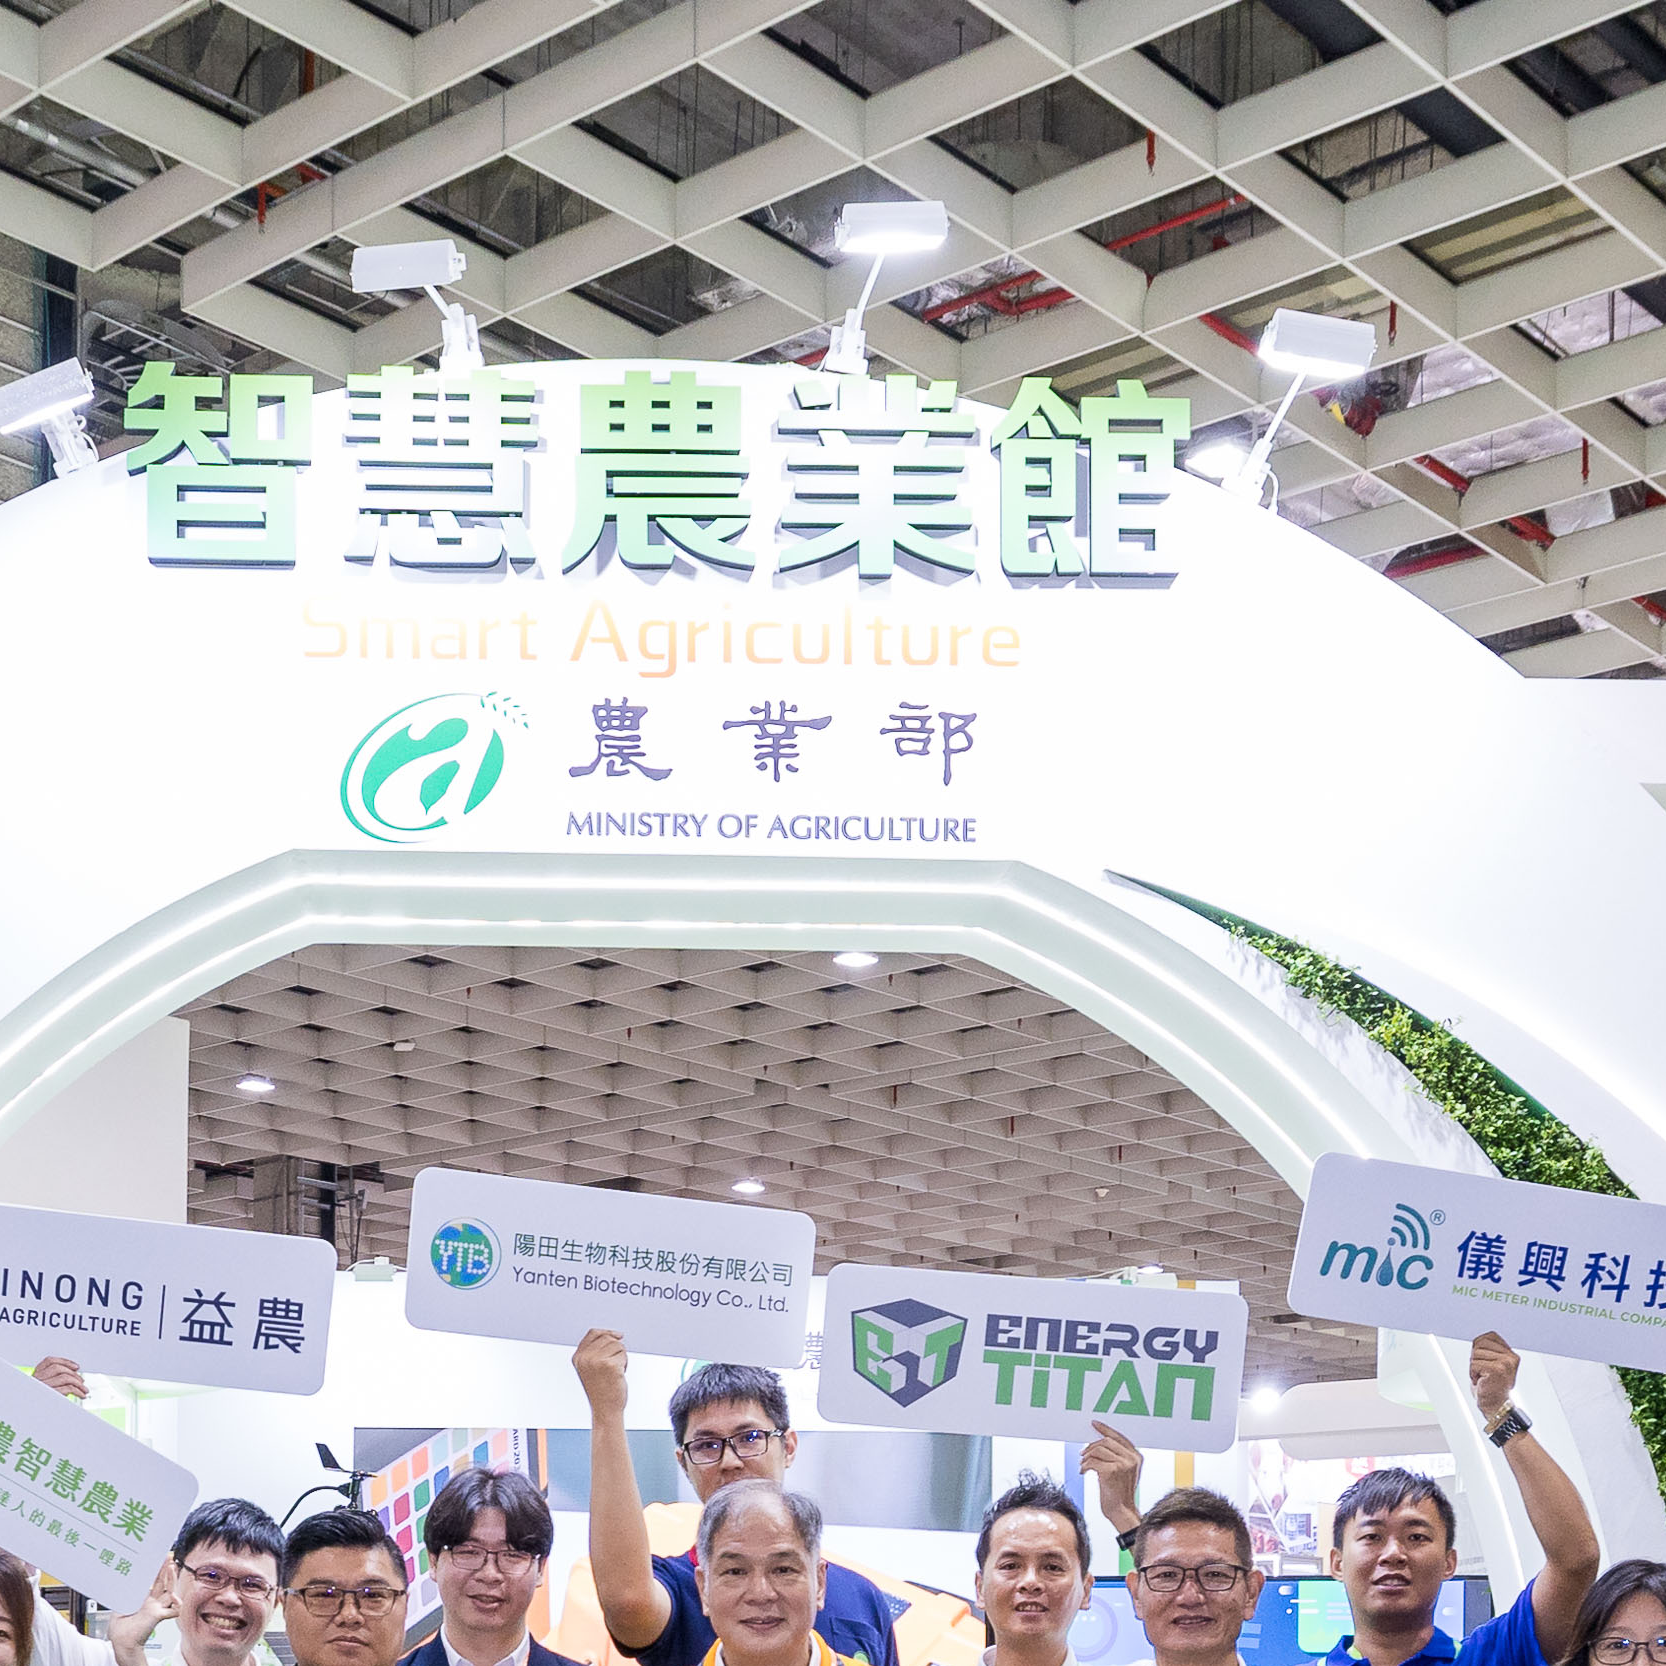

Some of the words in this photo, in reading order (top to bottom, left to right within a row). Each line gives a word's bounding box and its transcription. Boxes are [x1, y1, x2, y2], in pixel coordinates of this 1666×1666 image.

[124, 361, 1193, 578] 智慧農業館
[303, 602, 538, 661] Smart
[569, 600, 1021, 678] Agriculture
[568, 696, 978, 786] 農業部
[566, 811, 710, 839] MINISTRY
[717, 813, 759, 839] OF
[767, 814, 978, 843] AGRICULTURE
[513, 1233, 793, 1288] 陽田生物科技股份有限公司
[512, 1266, 578, 1290] Yanten
[584, 1274, 711, 1308] Biotechnology
[716, 1290, 753, 1309] Co.,
[758, 1295, 789, 1313] Ltd.
[1452, 1285, 1480, 1298] MIC
[1482, 1289, 1531, 1306] METER
[1533, 1298, 1617, 1320] INDUSTRIAL
[179, 1288, 305, 1354] 益農
[984, 1313, 1219, 1363] ENERGY
